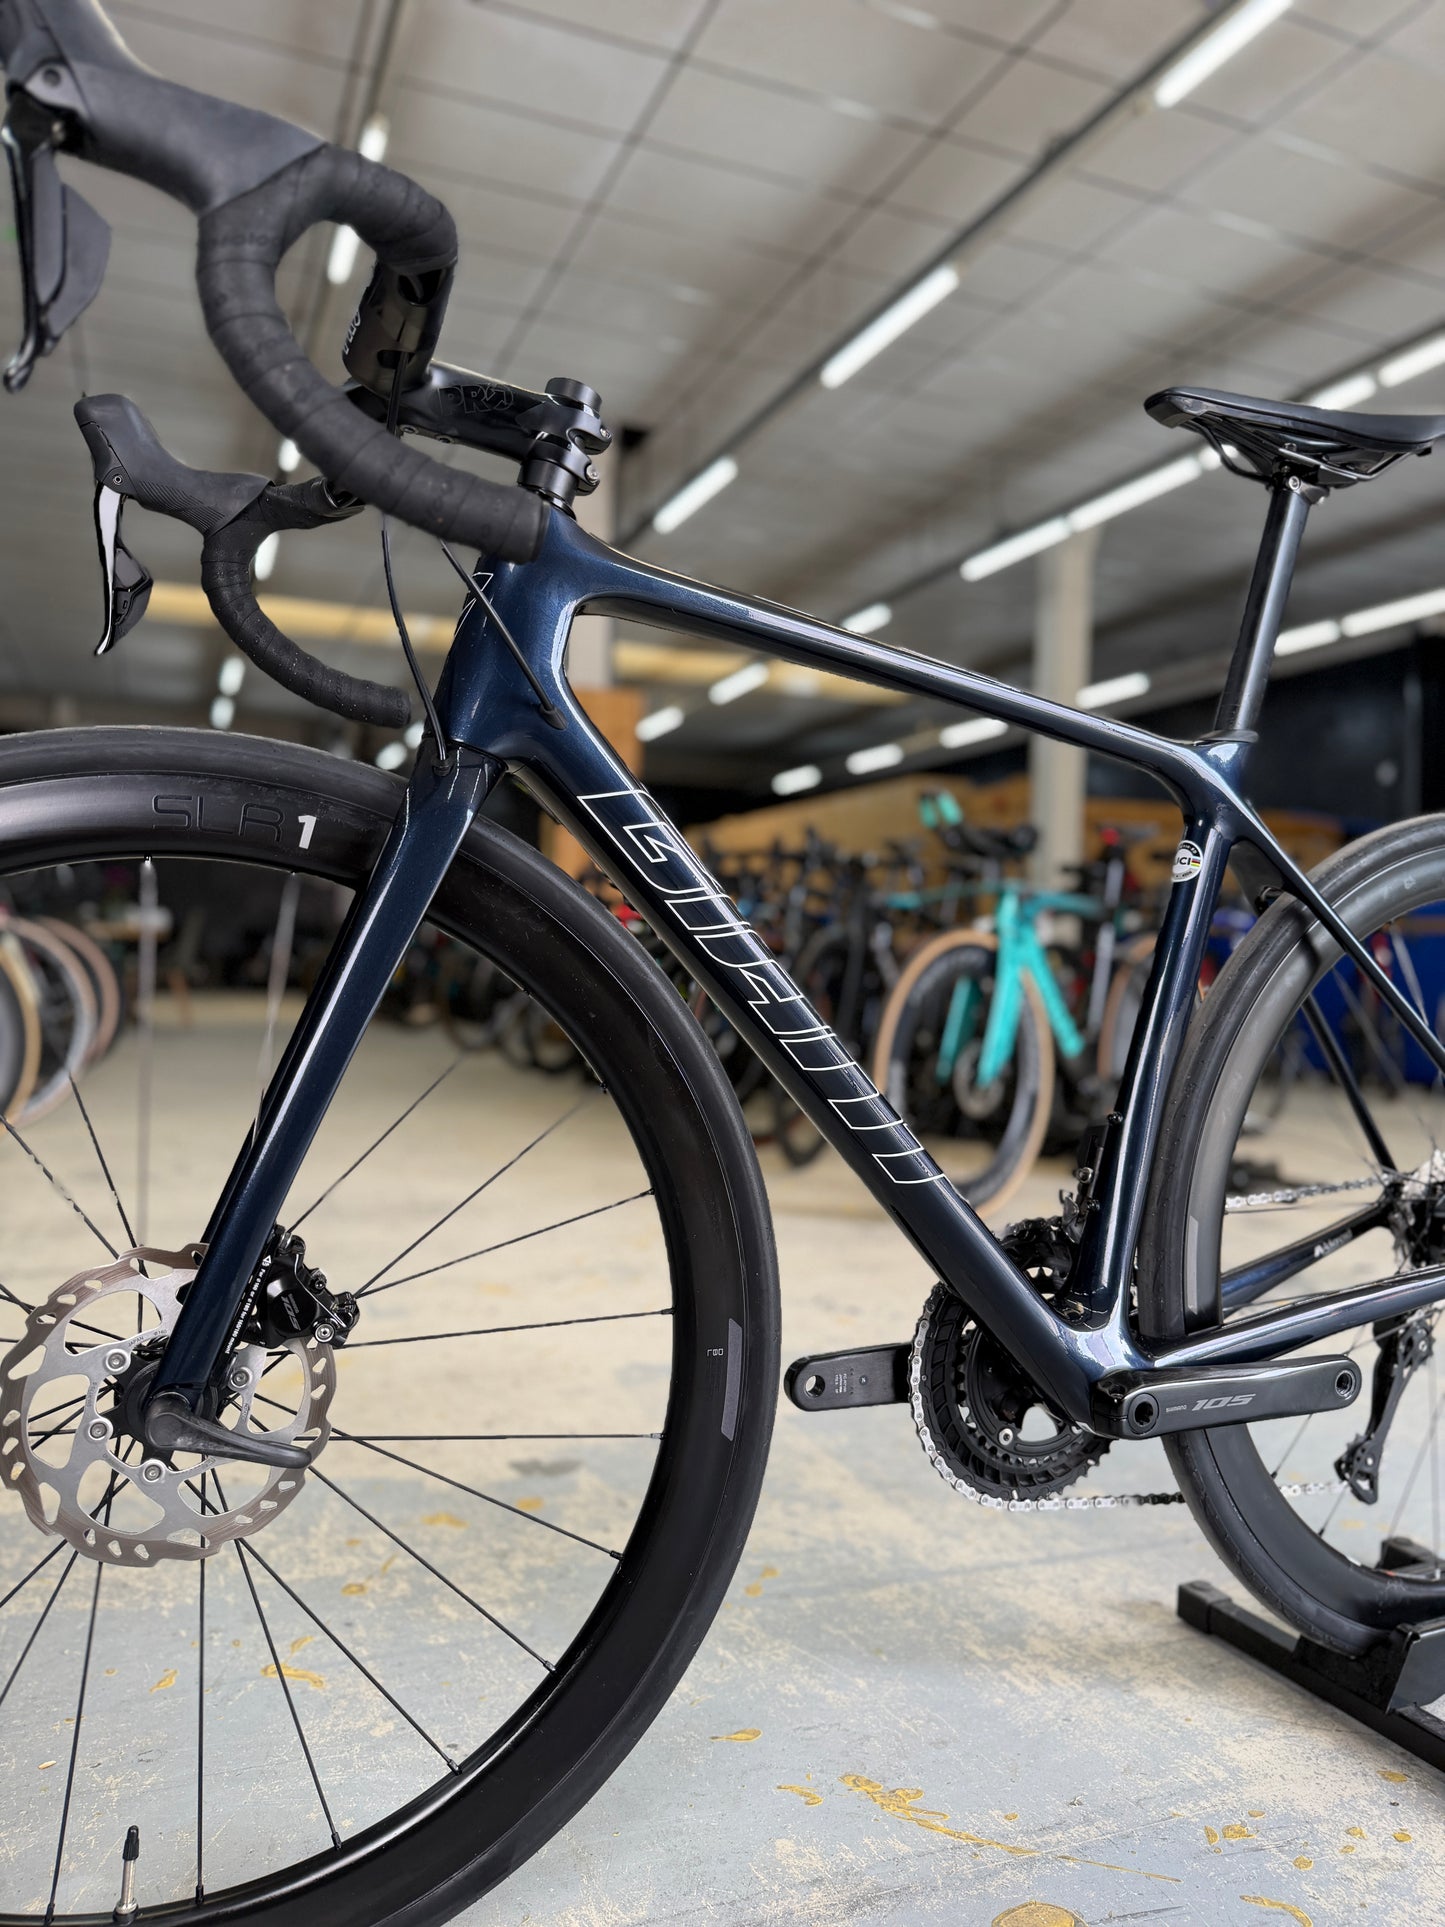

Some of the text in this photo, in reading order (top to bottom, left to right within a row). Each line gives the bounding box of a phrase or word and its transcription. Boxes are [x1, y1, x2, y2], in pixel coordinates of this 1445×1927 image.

[151, 793, 317, 850] SLR 1
[280, 1296, 301, 1331] 105
[1191, 1393, 1257, 1412] 105
